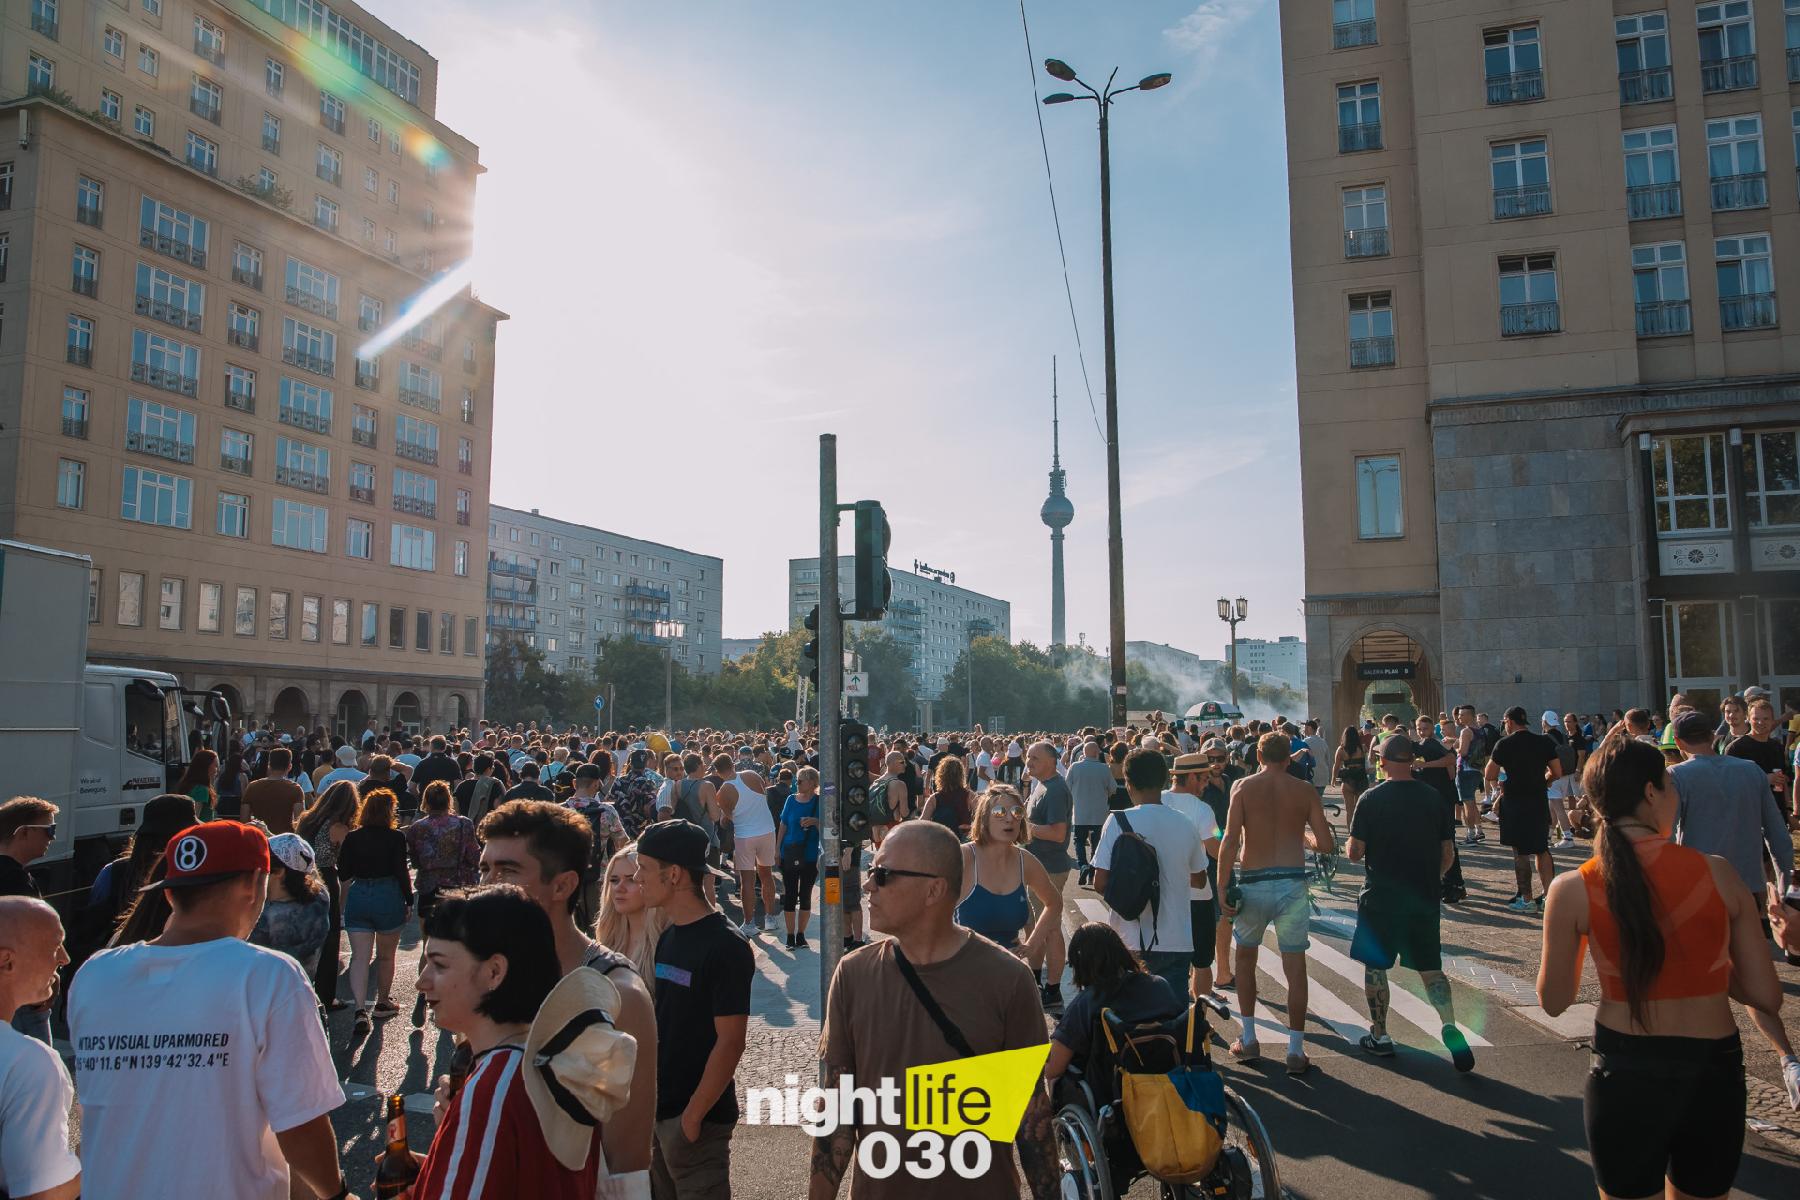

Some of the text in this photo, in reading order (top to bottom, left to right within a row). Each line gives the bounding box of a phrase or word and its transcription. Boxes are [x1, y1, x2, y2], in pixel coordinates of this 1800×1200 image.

[180, 838, 197, 870] 8
[108, 1034, 151, 1050] VISUAL
[153, 1033, 229, 1049] UPARMORED
